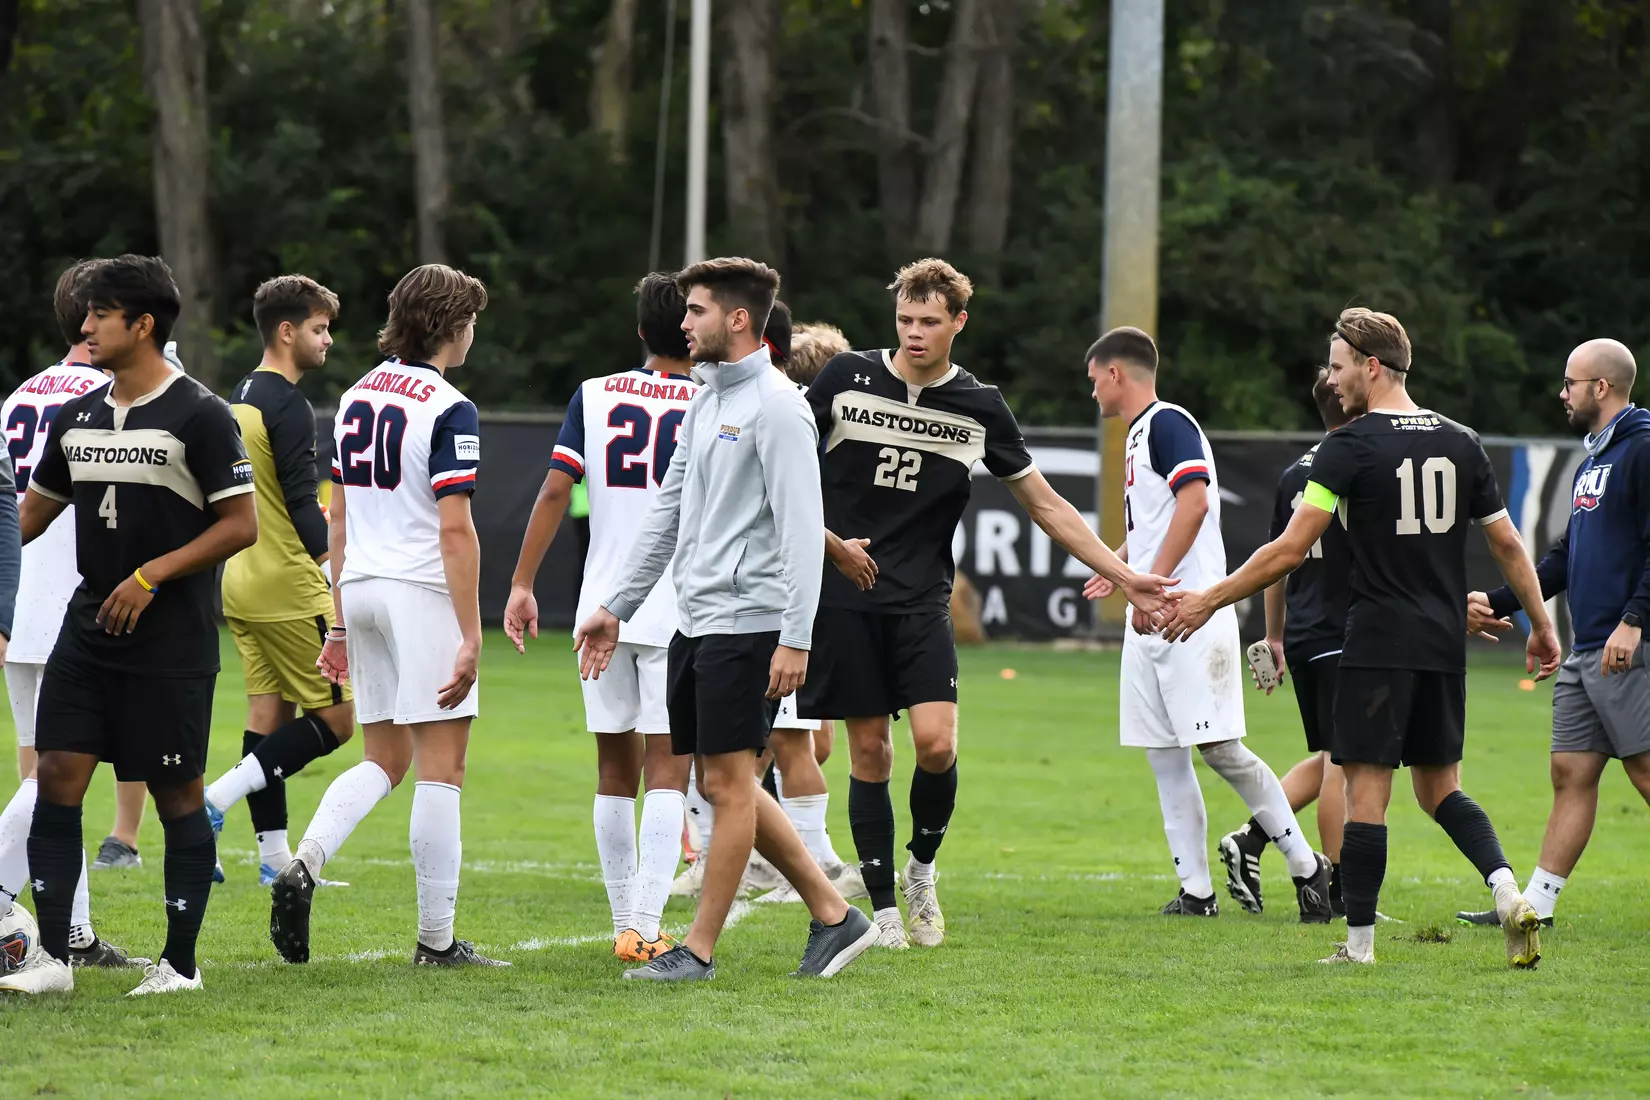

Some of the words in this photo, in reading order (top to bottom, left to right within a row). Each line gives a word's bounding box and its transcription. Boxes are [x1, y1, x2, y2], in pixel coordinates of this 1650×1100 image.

[15, 375, 94, 396] OLONIALS
[353, 371, 436, 403] OLONIALS
[340, 400, 408, 491] 20
[841, 405, 971, 444] MASTODONS
[65, 446, 169, 466] MASTODONS
[873, 447, 923, 492] 22
[98, 484, 118, 529] 4
[1395, 456, 1457, 535] 10
